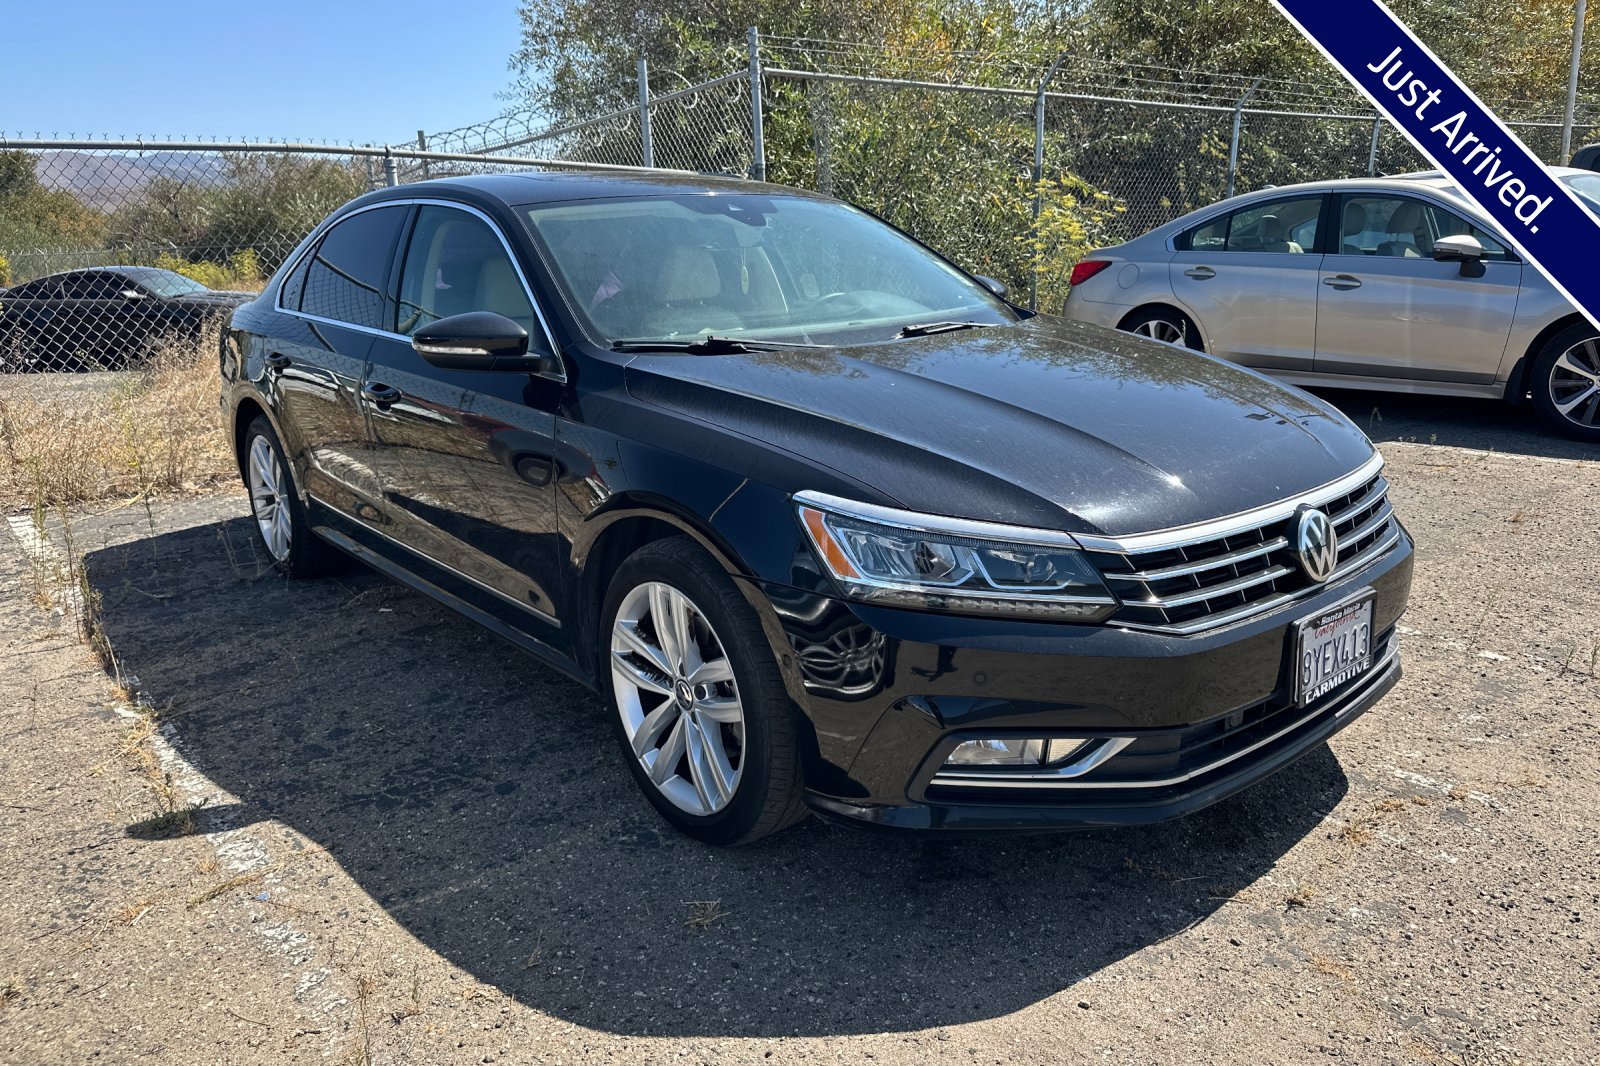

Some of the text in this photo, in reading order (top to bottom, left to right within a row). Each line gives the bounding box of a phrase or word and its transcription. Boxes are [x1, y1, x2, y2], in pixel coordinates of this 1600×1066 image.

[1320, 602, 1361, 626] Santa Maria
[1302, 622, 1369, 687] 8YEX413
[1305, 658, 1371, 705] CARMOTIVE
